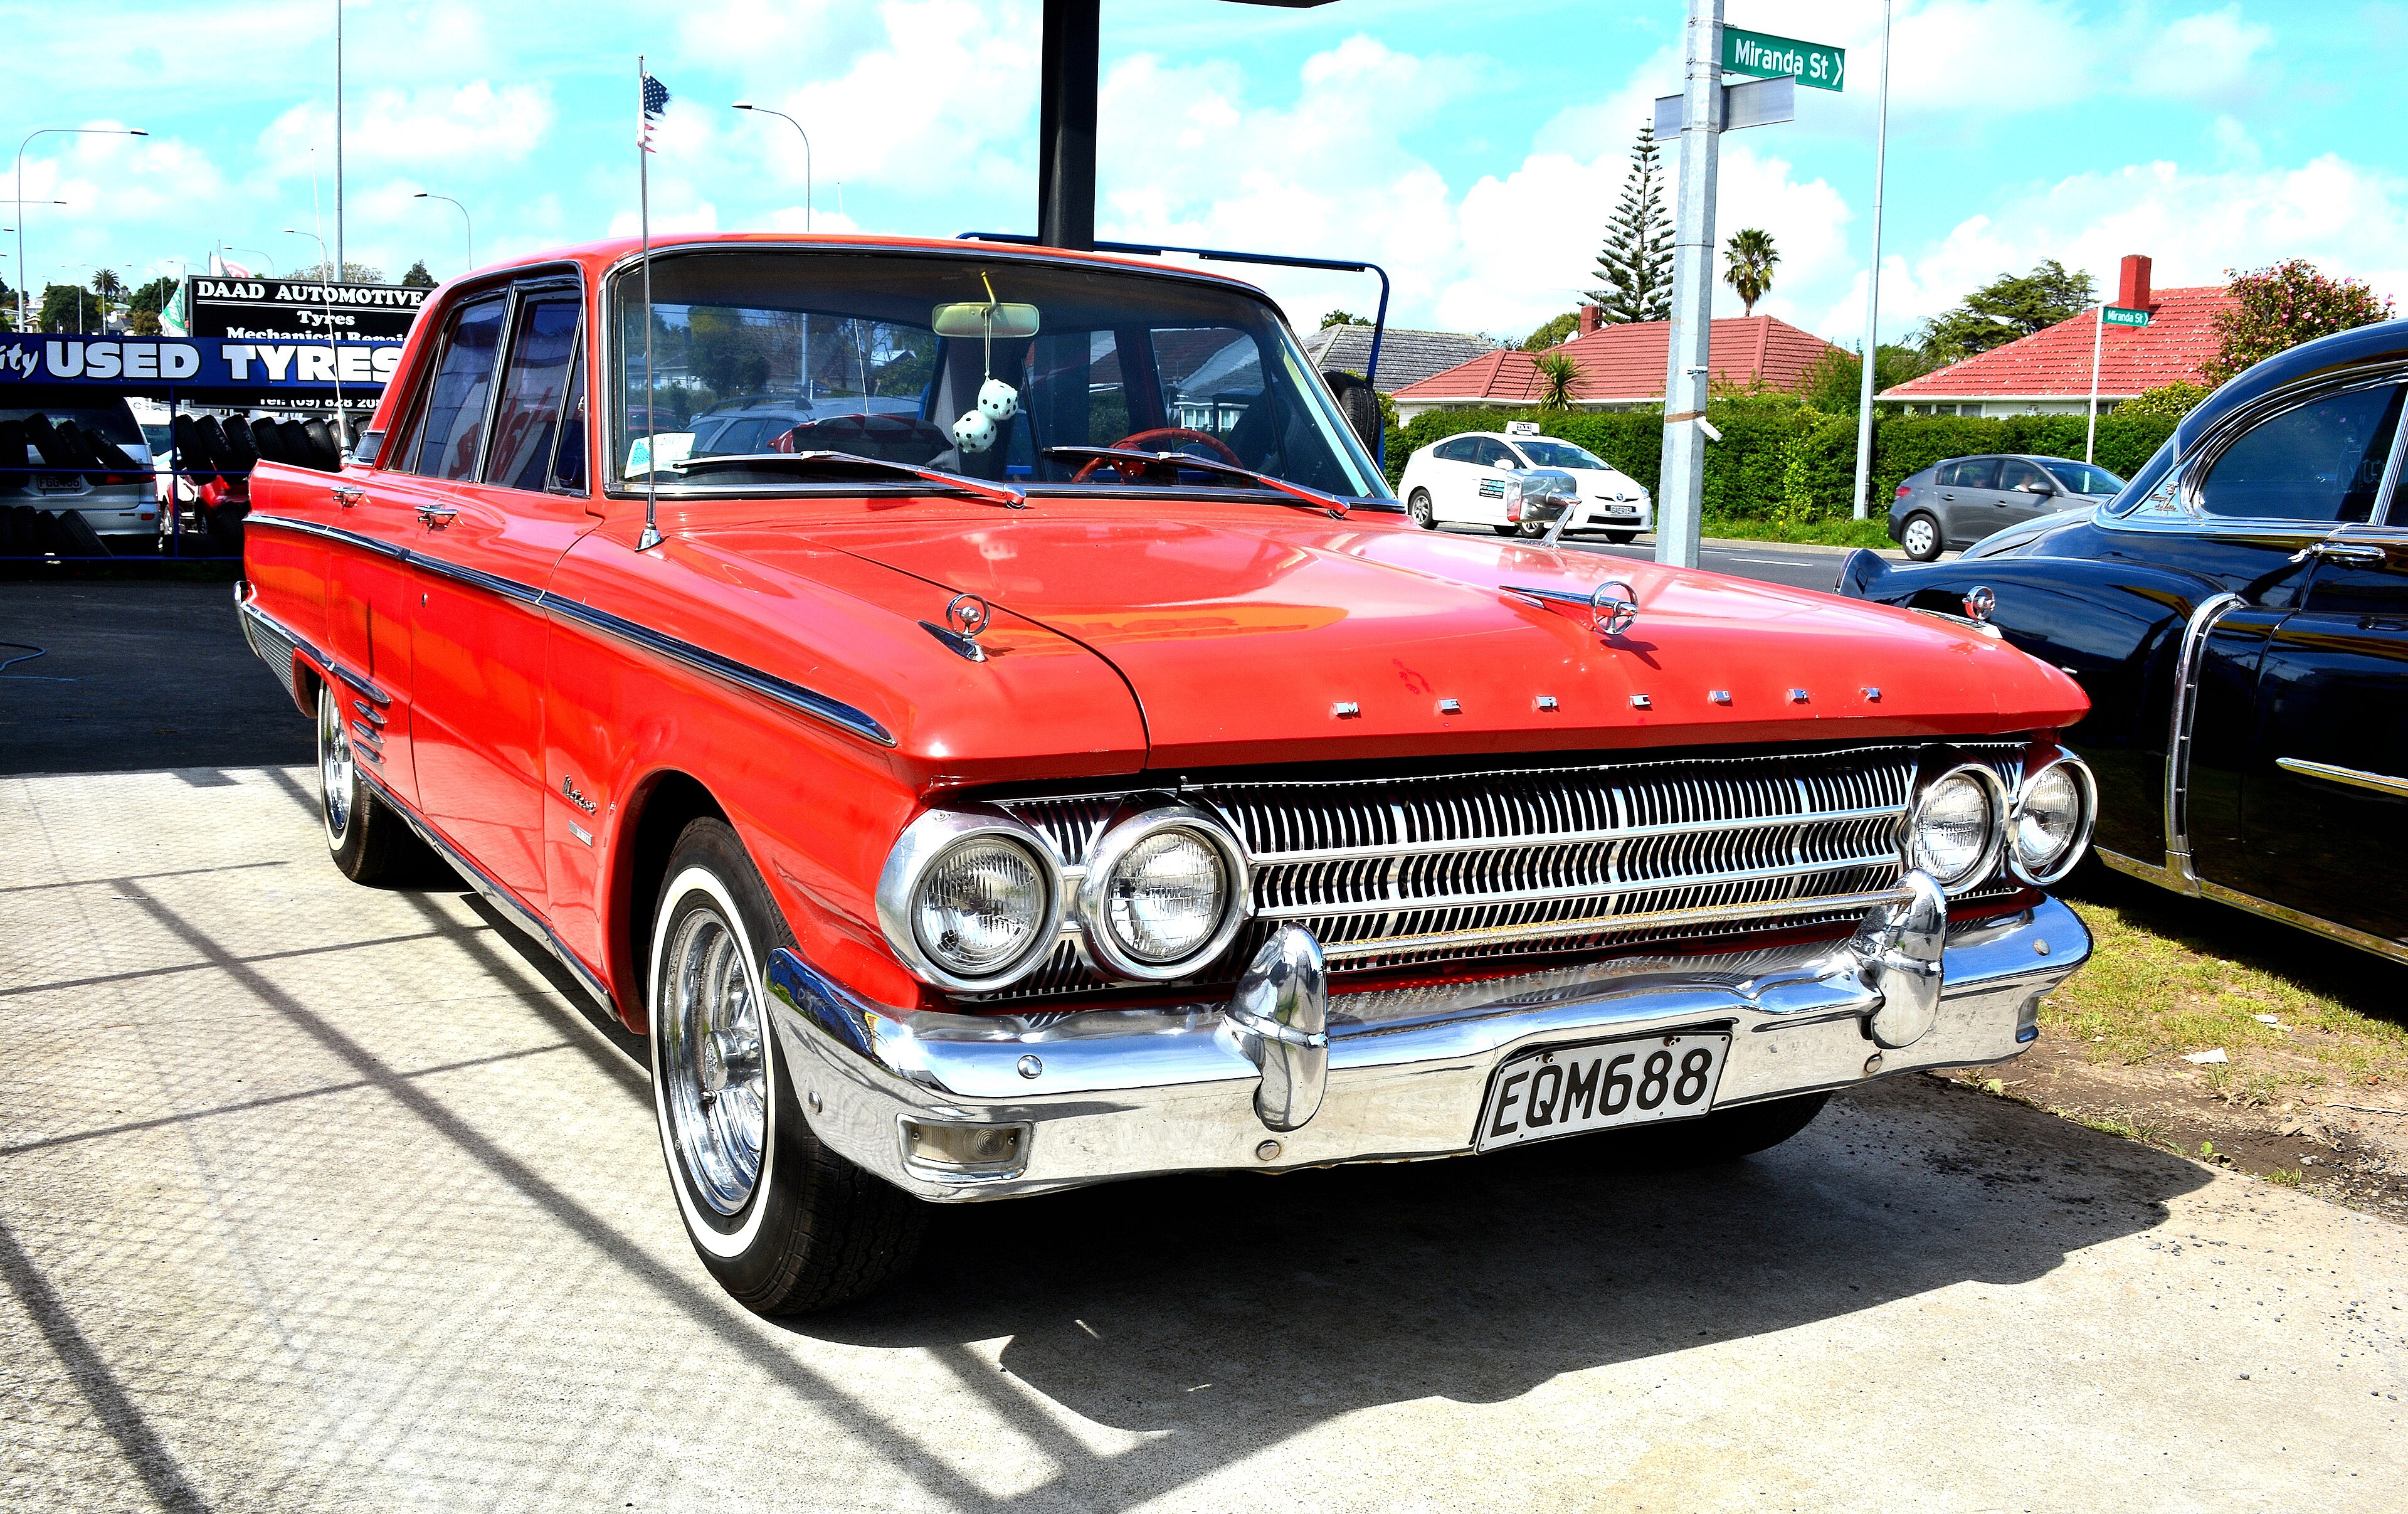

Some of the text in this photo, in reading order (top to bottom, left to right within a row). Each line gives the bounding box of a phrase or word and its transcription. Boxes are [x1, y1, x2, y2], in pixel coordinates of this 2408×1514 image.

[1735, 38, 1829, 80] Miranda St
[197, 281, 425, 307] DAAD AUTOMOTIVE
[297, 310, 356, 326] Tyres
[2108, 310, 2143, 324] Miranda St
[226, 327, 342, 341] Mechanical
[46, 341, 199, 378] USED
[223, 345, 403, 383] TYRES
[1490, 1048, 1713, 1138] EQM688
